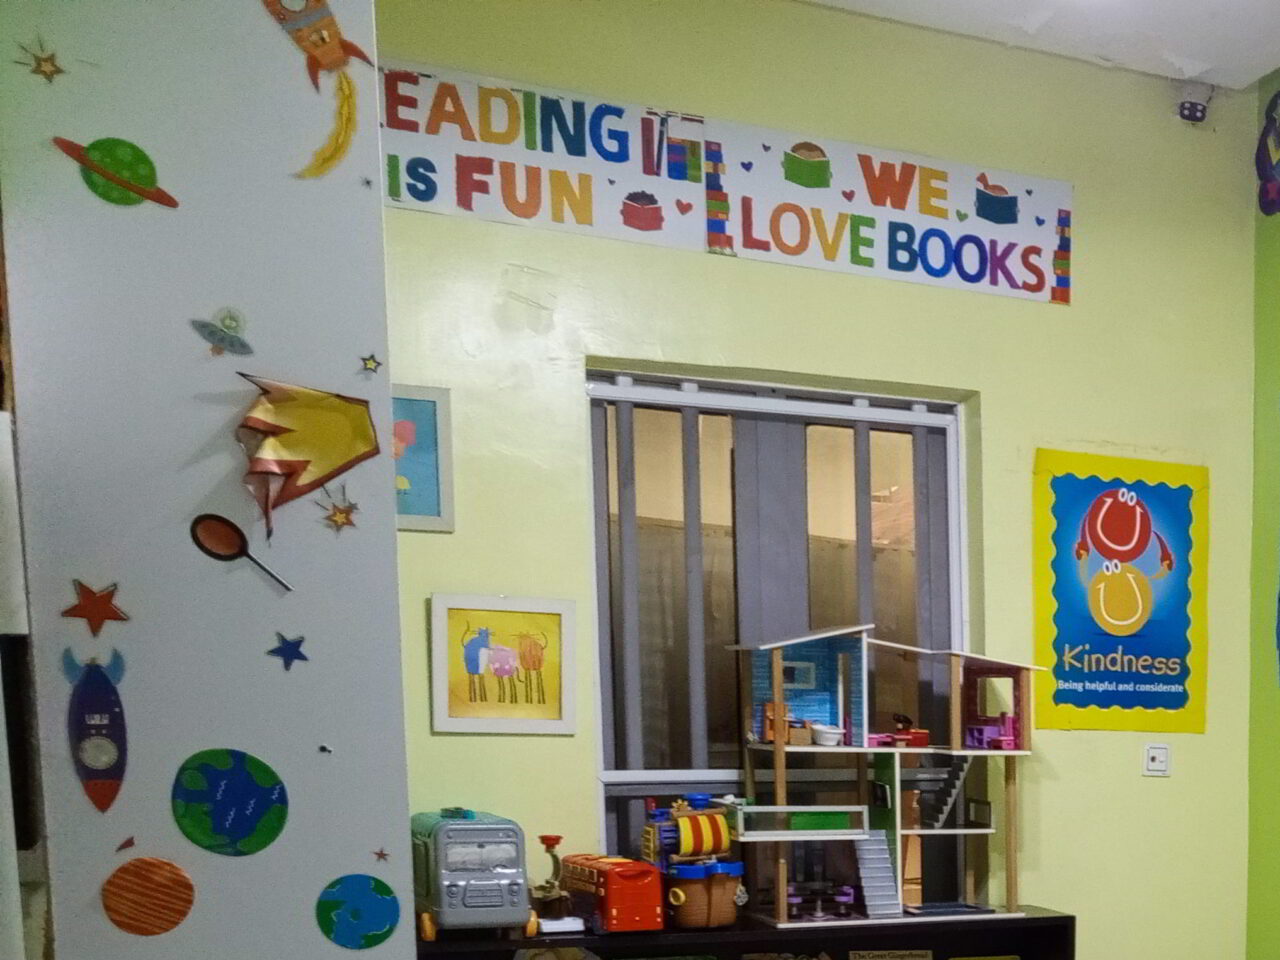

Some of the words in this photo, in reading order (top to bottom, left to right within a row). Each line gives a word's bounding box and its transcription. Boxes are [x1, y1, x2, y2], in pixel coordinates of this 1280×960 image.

[379, 70, 630, 164] EADING
[387, 153, 438, 204] IS
[455, 153, 593, 227] FUN
[857, 153, 949, 218] WE
[741, 196, 877, 268] LOVE
[888, 221, 1047, 293] BOOKS
[1058, 680, 1084, 692] Being
[1085, 680, 1116, 693] helpful
[1117, 681, 1134, 692] and
[1135, 682, 1185, 693] considerate
[1062, 643, 1182, 676] Kindness
